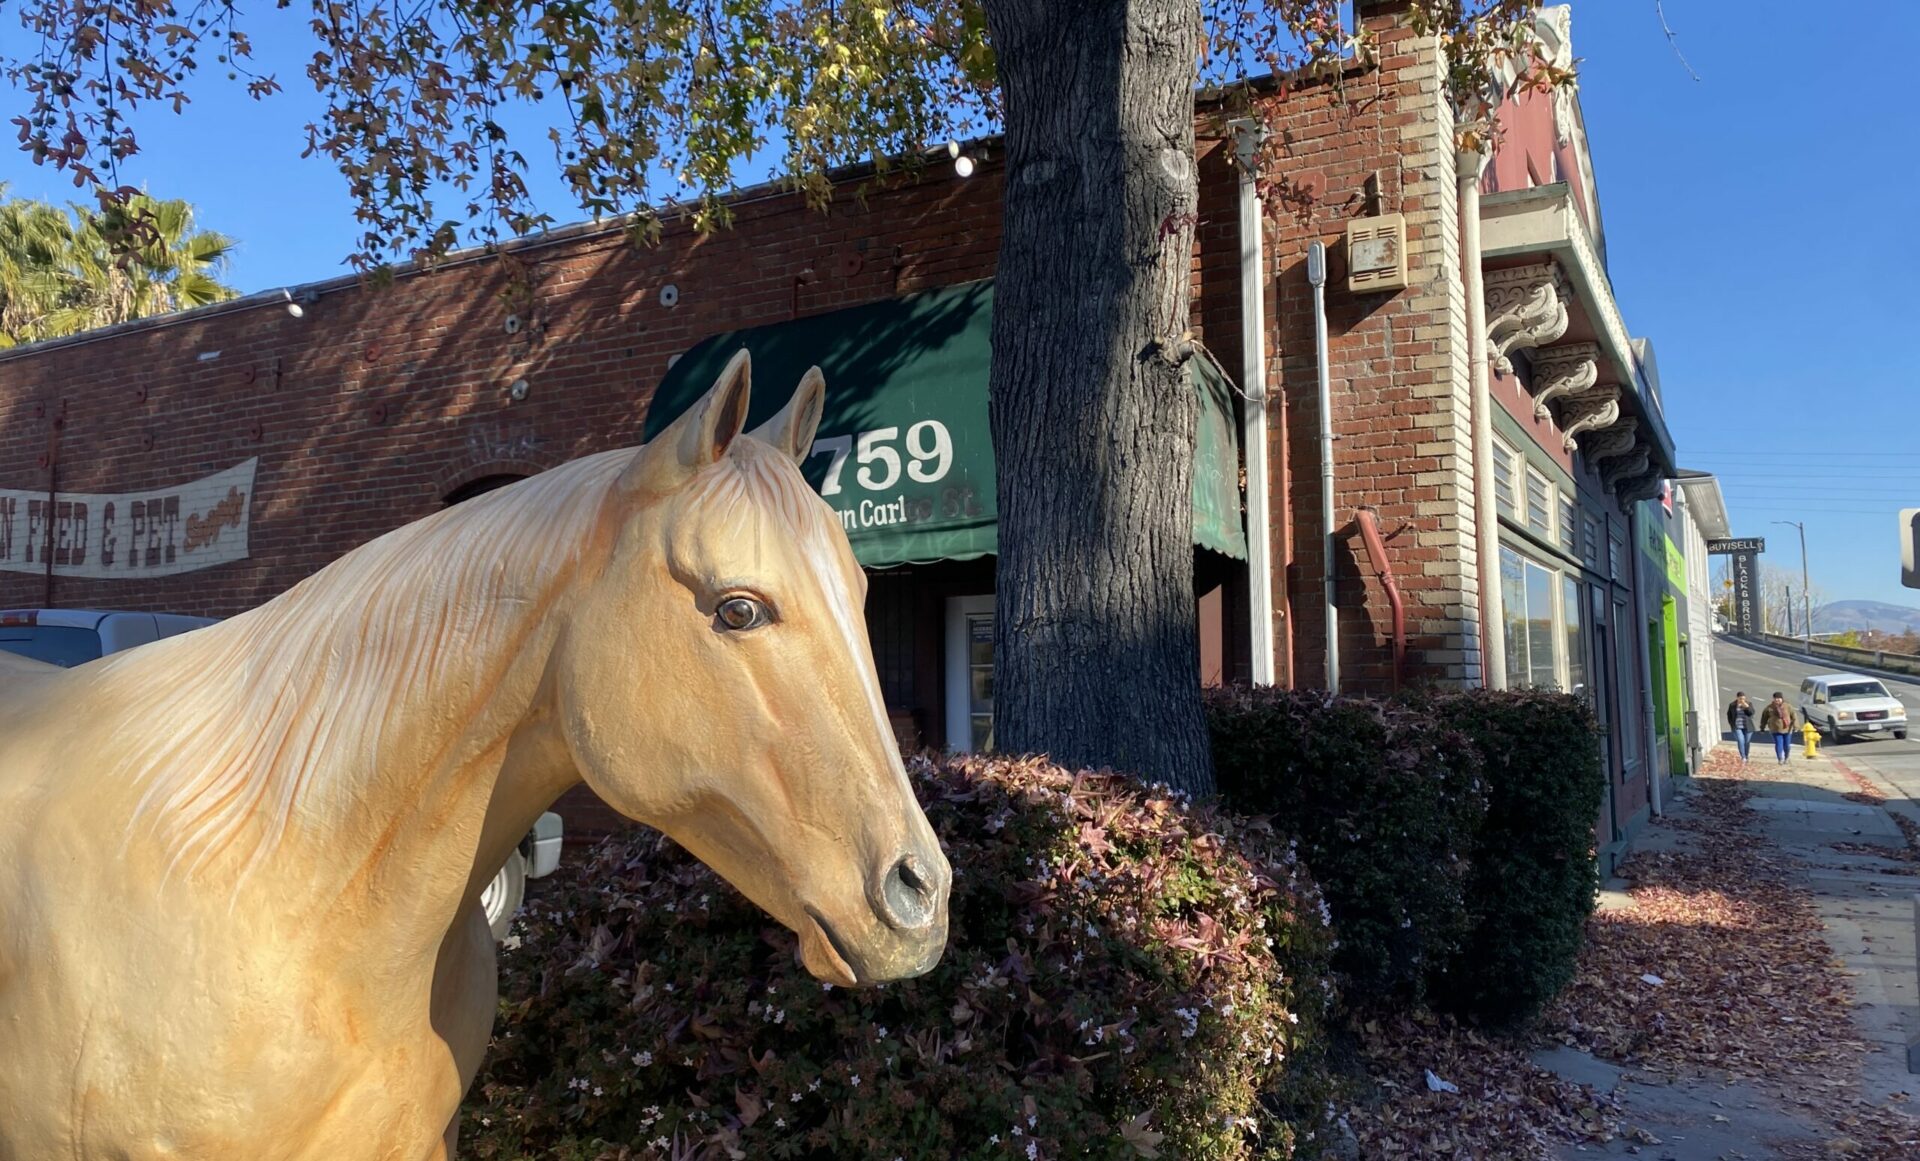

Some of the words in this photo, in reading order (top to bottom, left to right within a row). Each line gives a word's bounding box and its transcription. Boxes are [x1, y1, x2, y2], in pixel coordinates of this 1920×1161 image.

[811, 420, 953, 496] 759
[26, 499, 88, 565] FEED
[102, 501, 117, 567] &
[129, 495, 180, 567] PET
[1738, 555, 1749, 590] BLACK
[1742, 600, 1752, 633] BROWN
